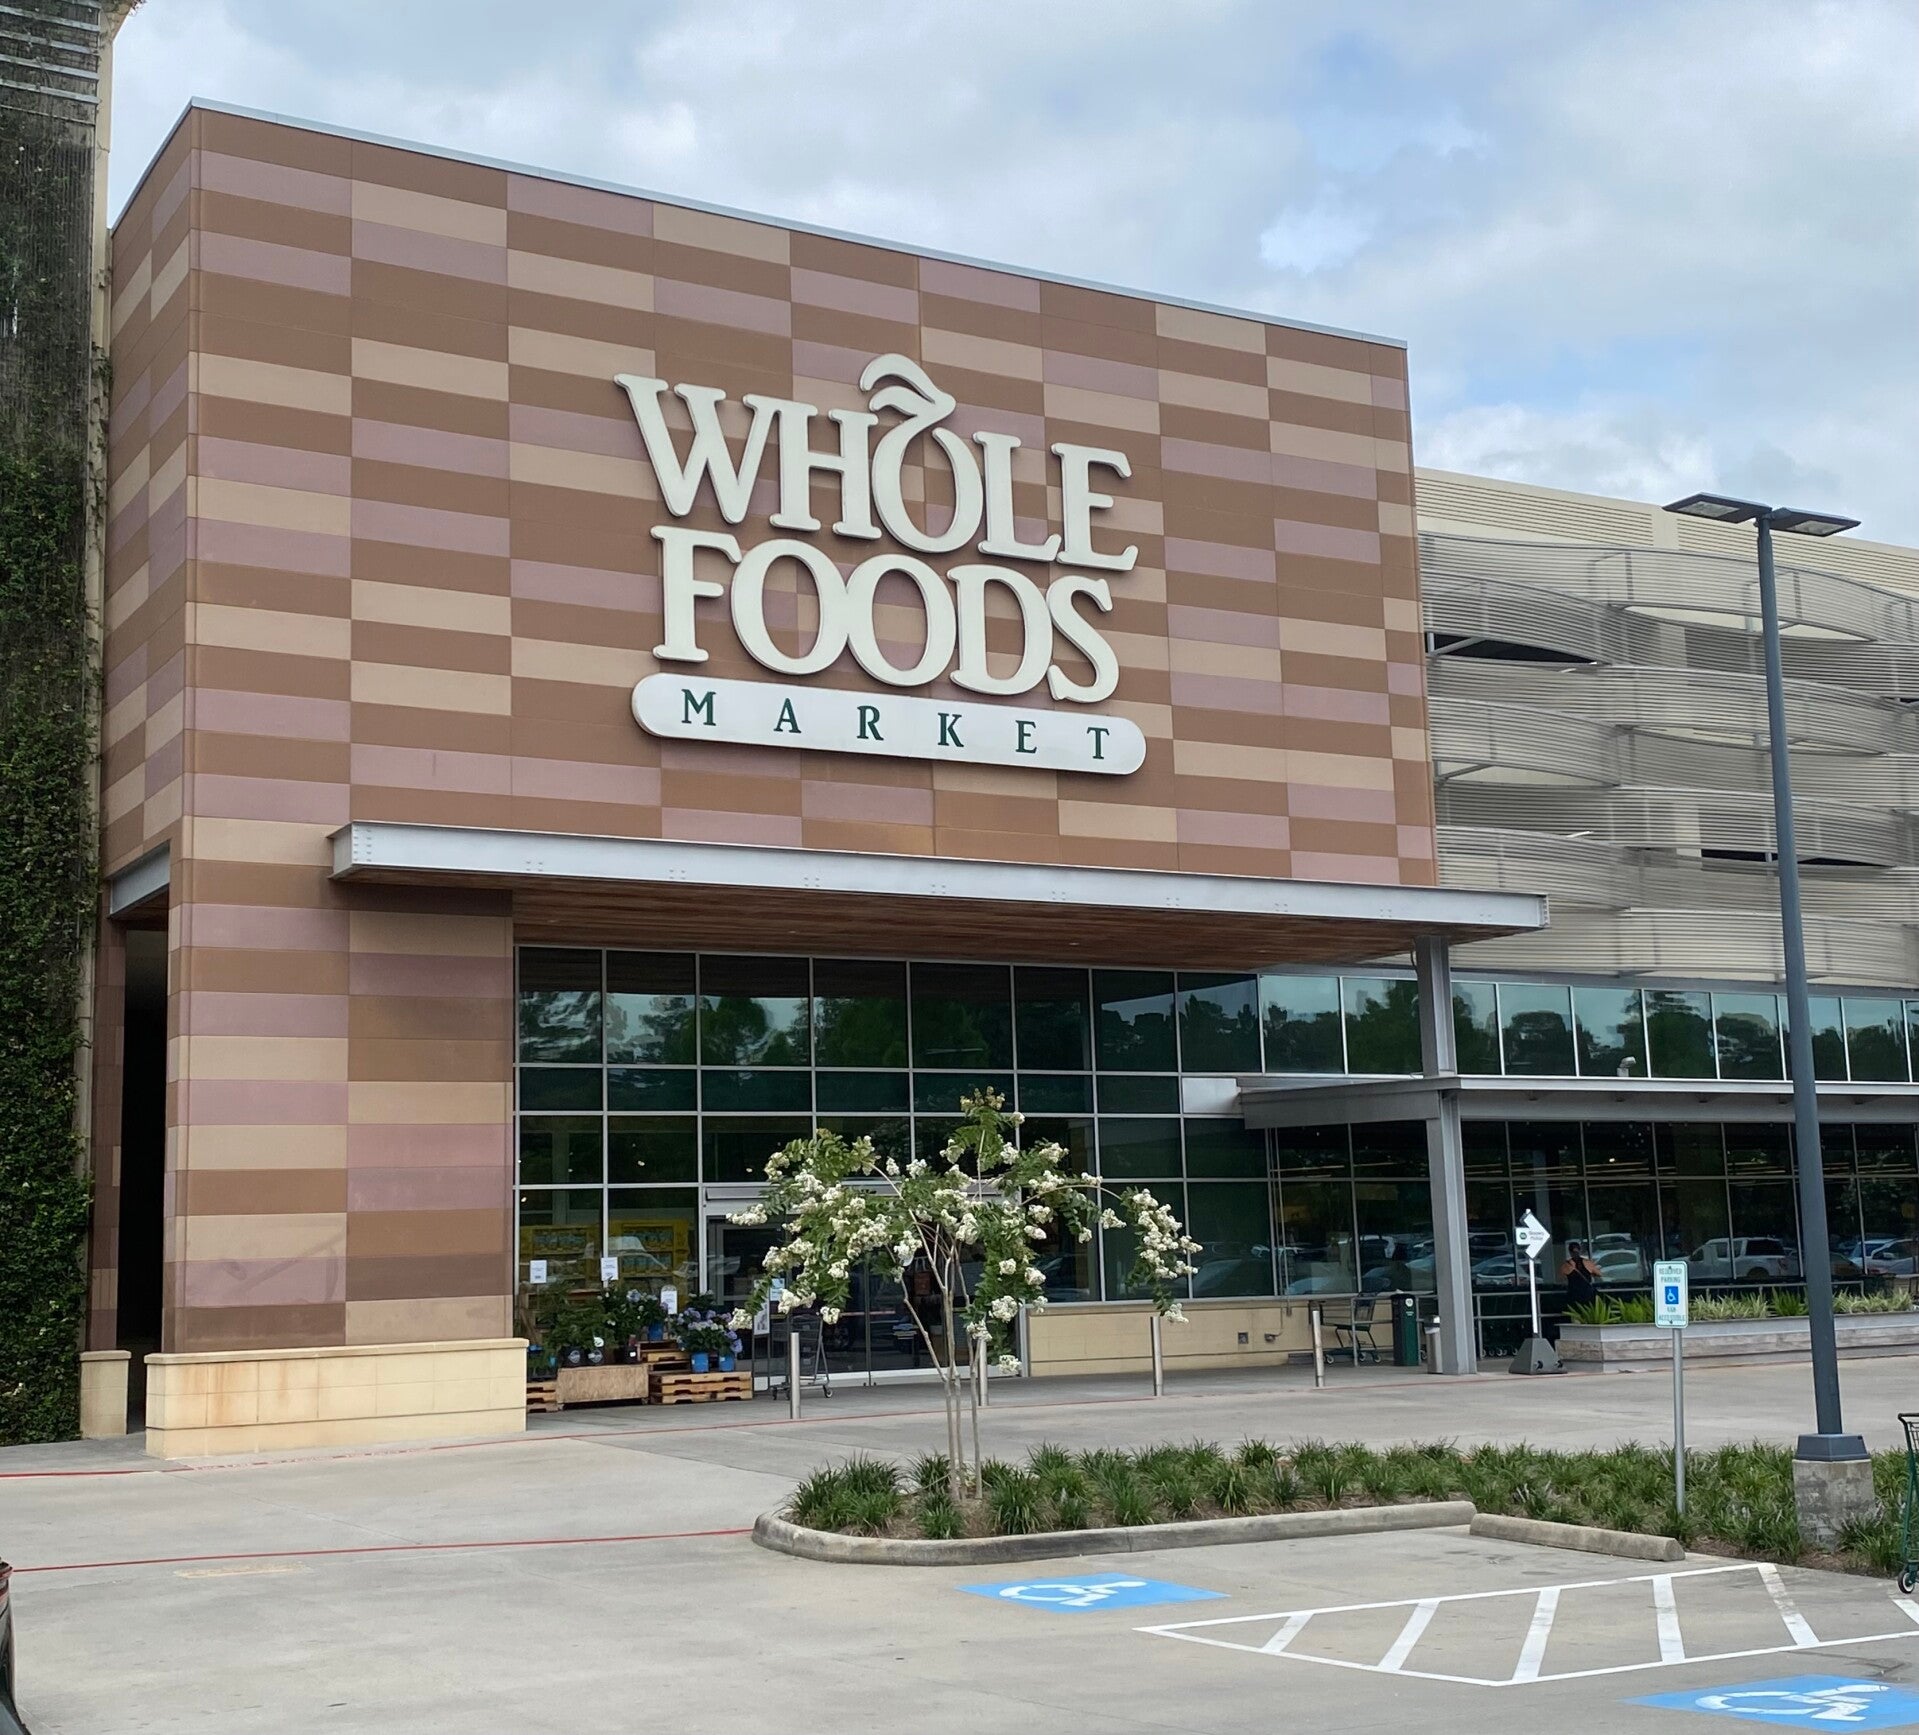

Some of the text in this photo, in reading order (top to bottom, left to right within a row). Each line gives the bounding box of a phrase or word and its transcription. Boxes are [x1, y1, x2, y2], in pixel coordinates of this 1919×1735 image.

[613, 353, 1138, 571] WHOLE
[650, 525, 1120, 704] FOODS
[681, 688, 1111, 760] MARKET
